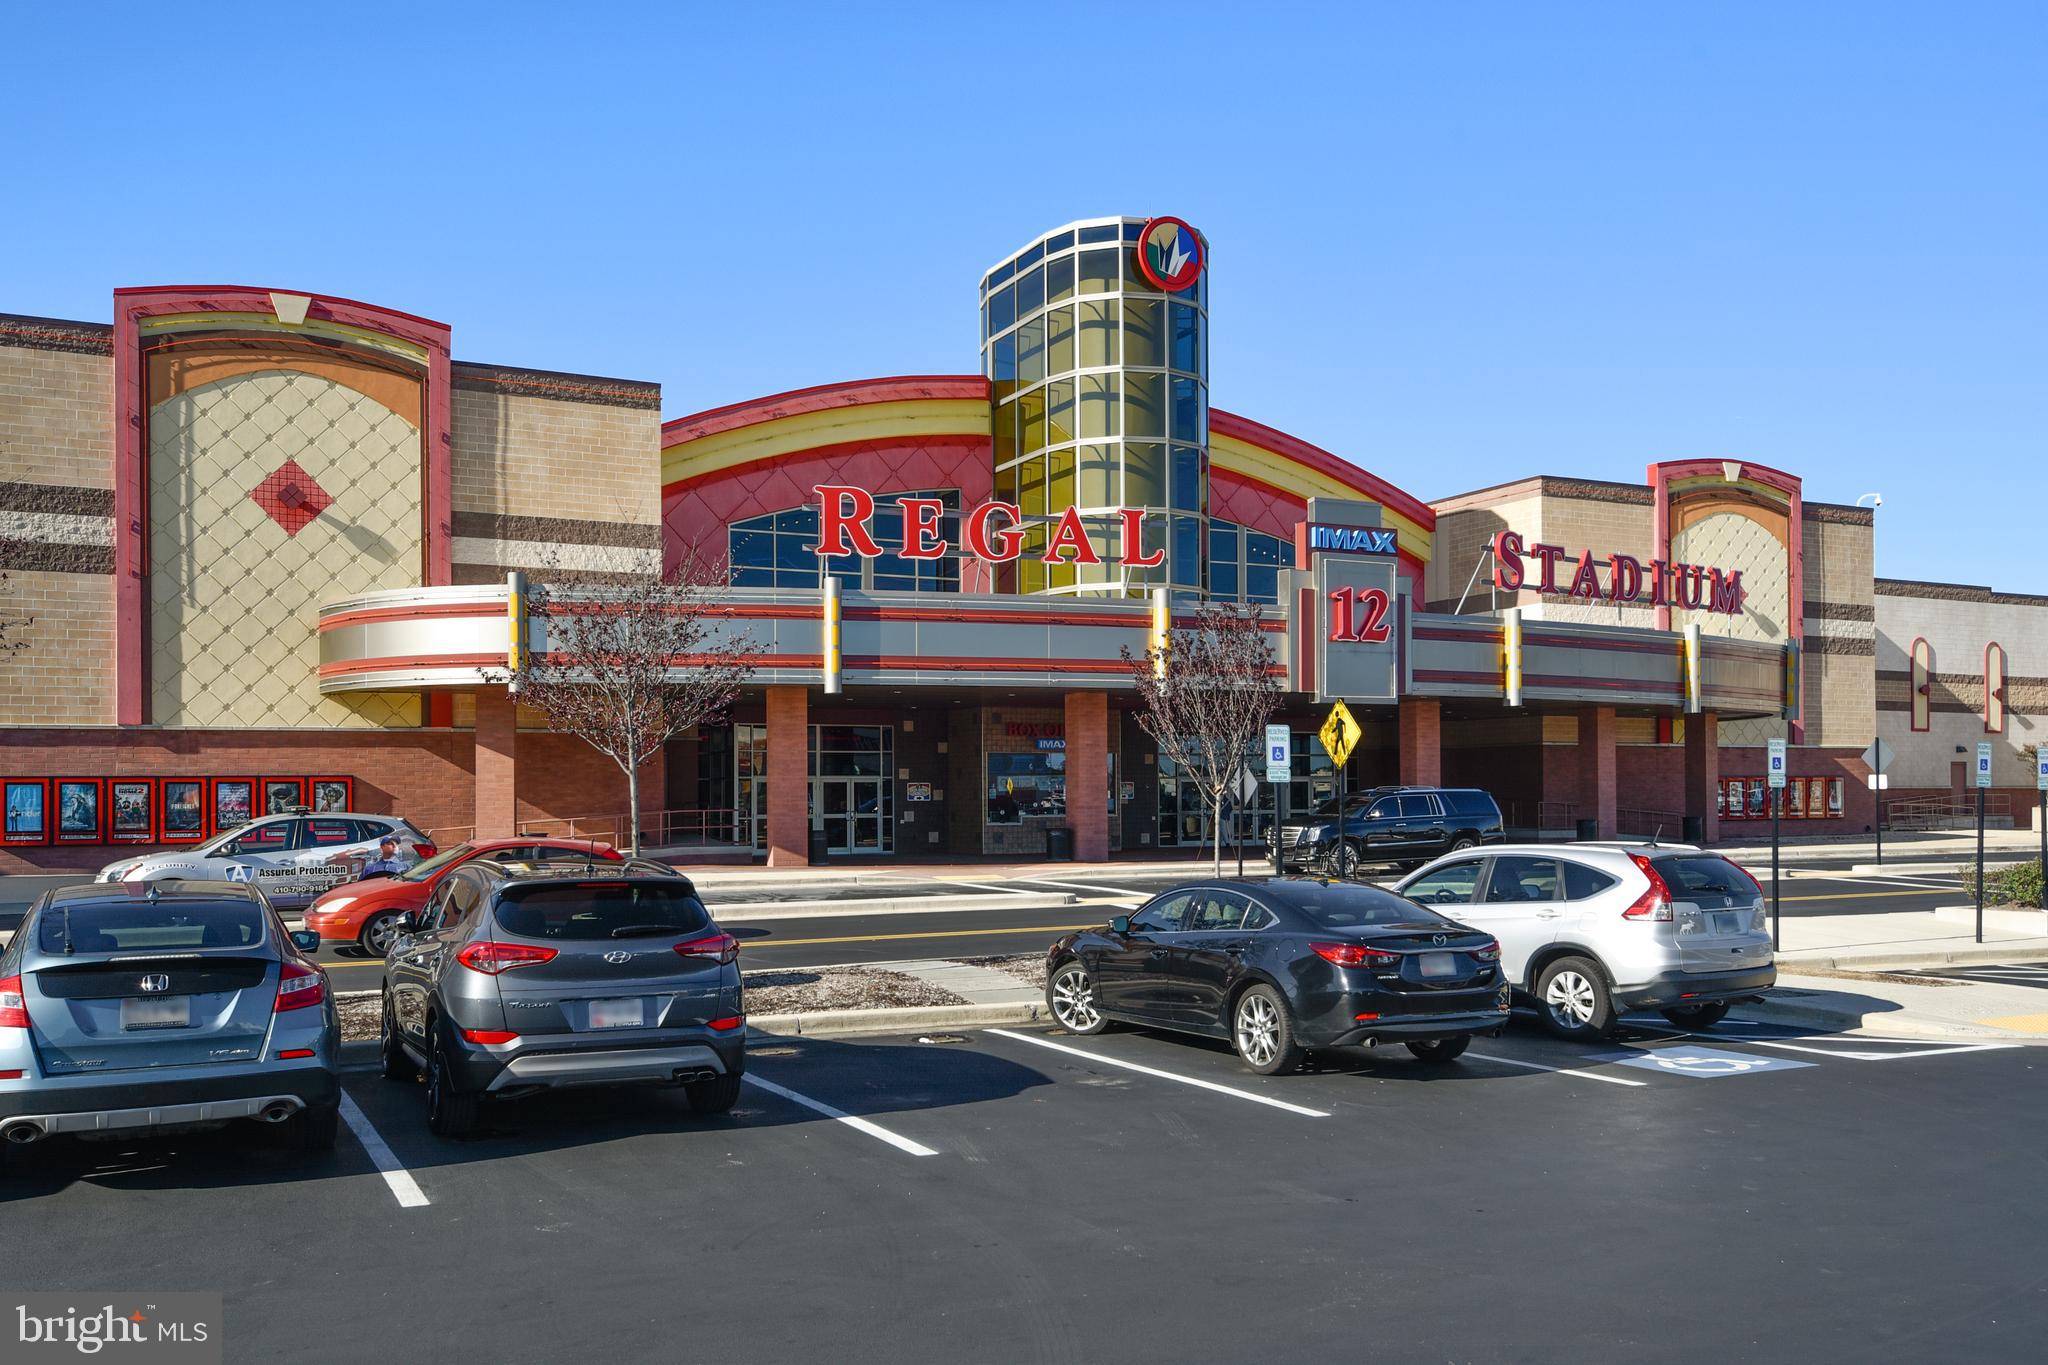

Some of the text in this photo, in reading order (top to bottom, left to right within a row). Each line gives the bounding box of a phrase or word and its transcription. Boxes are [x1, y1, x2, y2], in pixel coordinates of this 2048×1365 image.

[813, 484, 1165, 568] REGAL
[1311, 526, 1397, 553] IMAX
[1494, 530, 1744, 615] STADIUM
[1329, 586, 1392, 643] 12
[1008, 721, 1041, 736] BOX
[146, 862, 198, 873] SECURITY
[259, 864, 346, 877] Assured Protection
